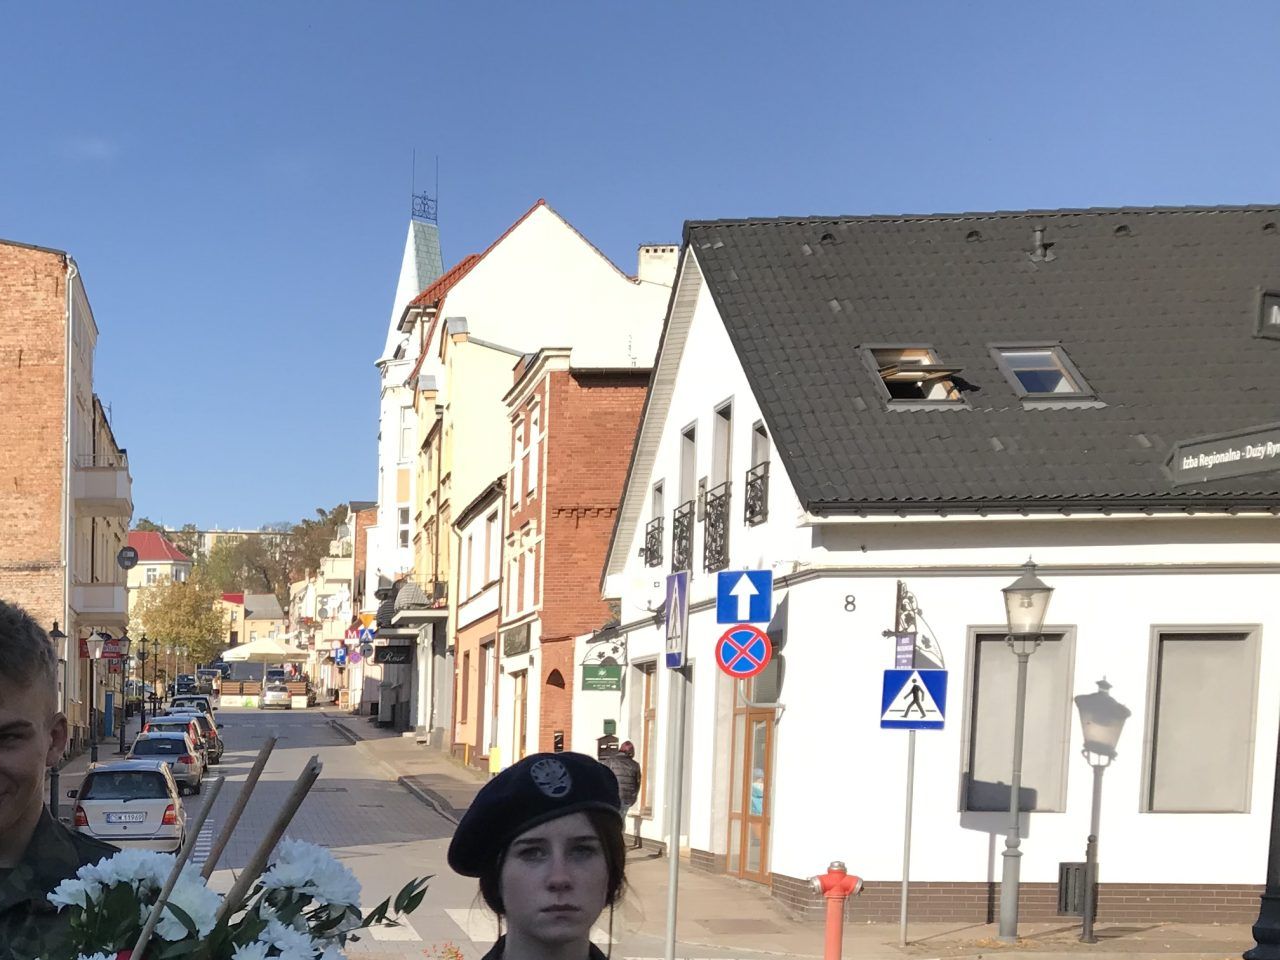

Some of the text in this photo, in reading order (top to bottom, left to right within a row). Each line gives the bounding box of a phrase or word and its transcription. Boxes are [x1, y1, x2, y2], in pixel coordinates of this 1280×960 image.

[1183, 456, 1198, 469] Izba
[1199, 448, 1240, 468] Regionalna
[1246, 443, 1266, 459] Duży
[844, 594, 856, 612] 8
[348, 630, 357, 639] M
[338, 649, 344, 658] P
